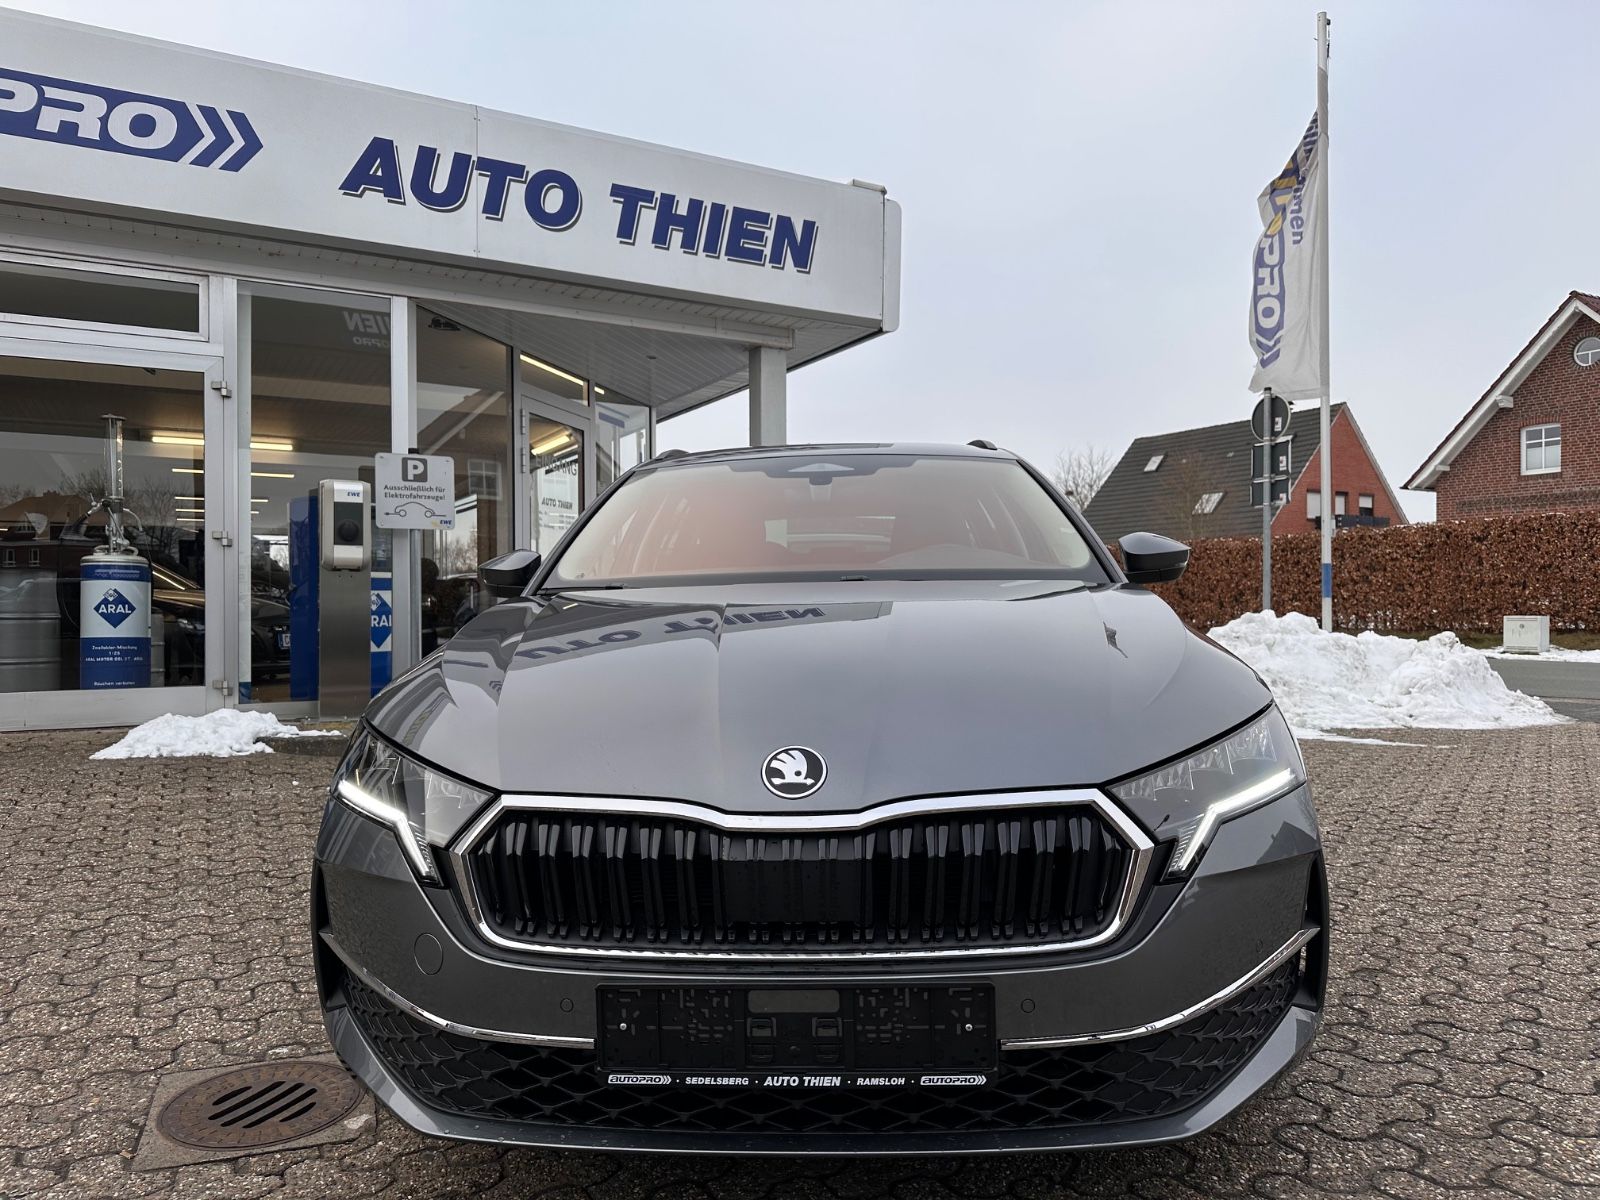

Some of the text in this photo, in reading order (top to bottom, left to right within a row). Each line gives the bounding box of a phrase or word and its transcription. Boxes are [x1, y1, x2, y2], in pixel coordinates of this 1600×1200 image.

[338, 136, 818, 275] AUTO THIEN
[407, 459, 425, 480] P
[384, 484, 446, 494] Ausschließlich für
[347, 491, 361, 499] EWE
[384, 492, 446, 502] Elektrofahrzeuge!
[542, 497, 556, 508] AUTO
[98, 604, 131, 613] ARAL
[371, 615, 392, 628] RA
[685, 1077, 749, 1085] SEDELSBERG
[763, 1076, 799, 1087] AUTO
[803, 1076, 841, 1087] THIEN
[856, 1077, 906, 1086] RAMSLOH
